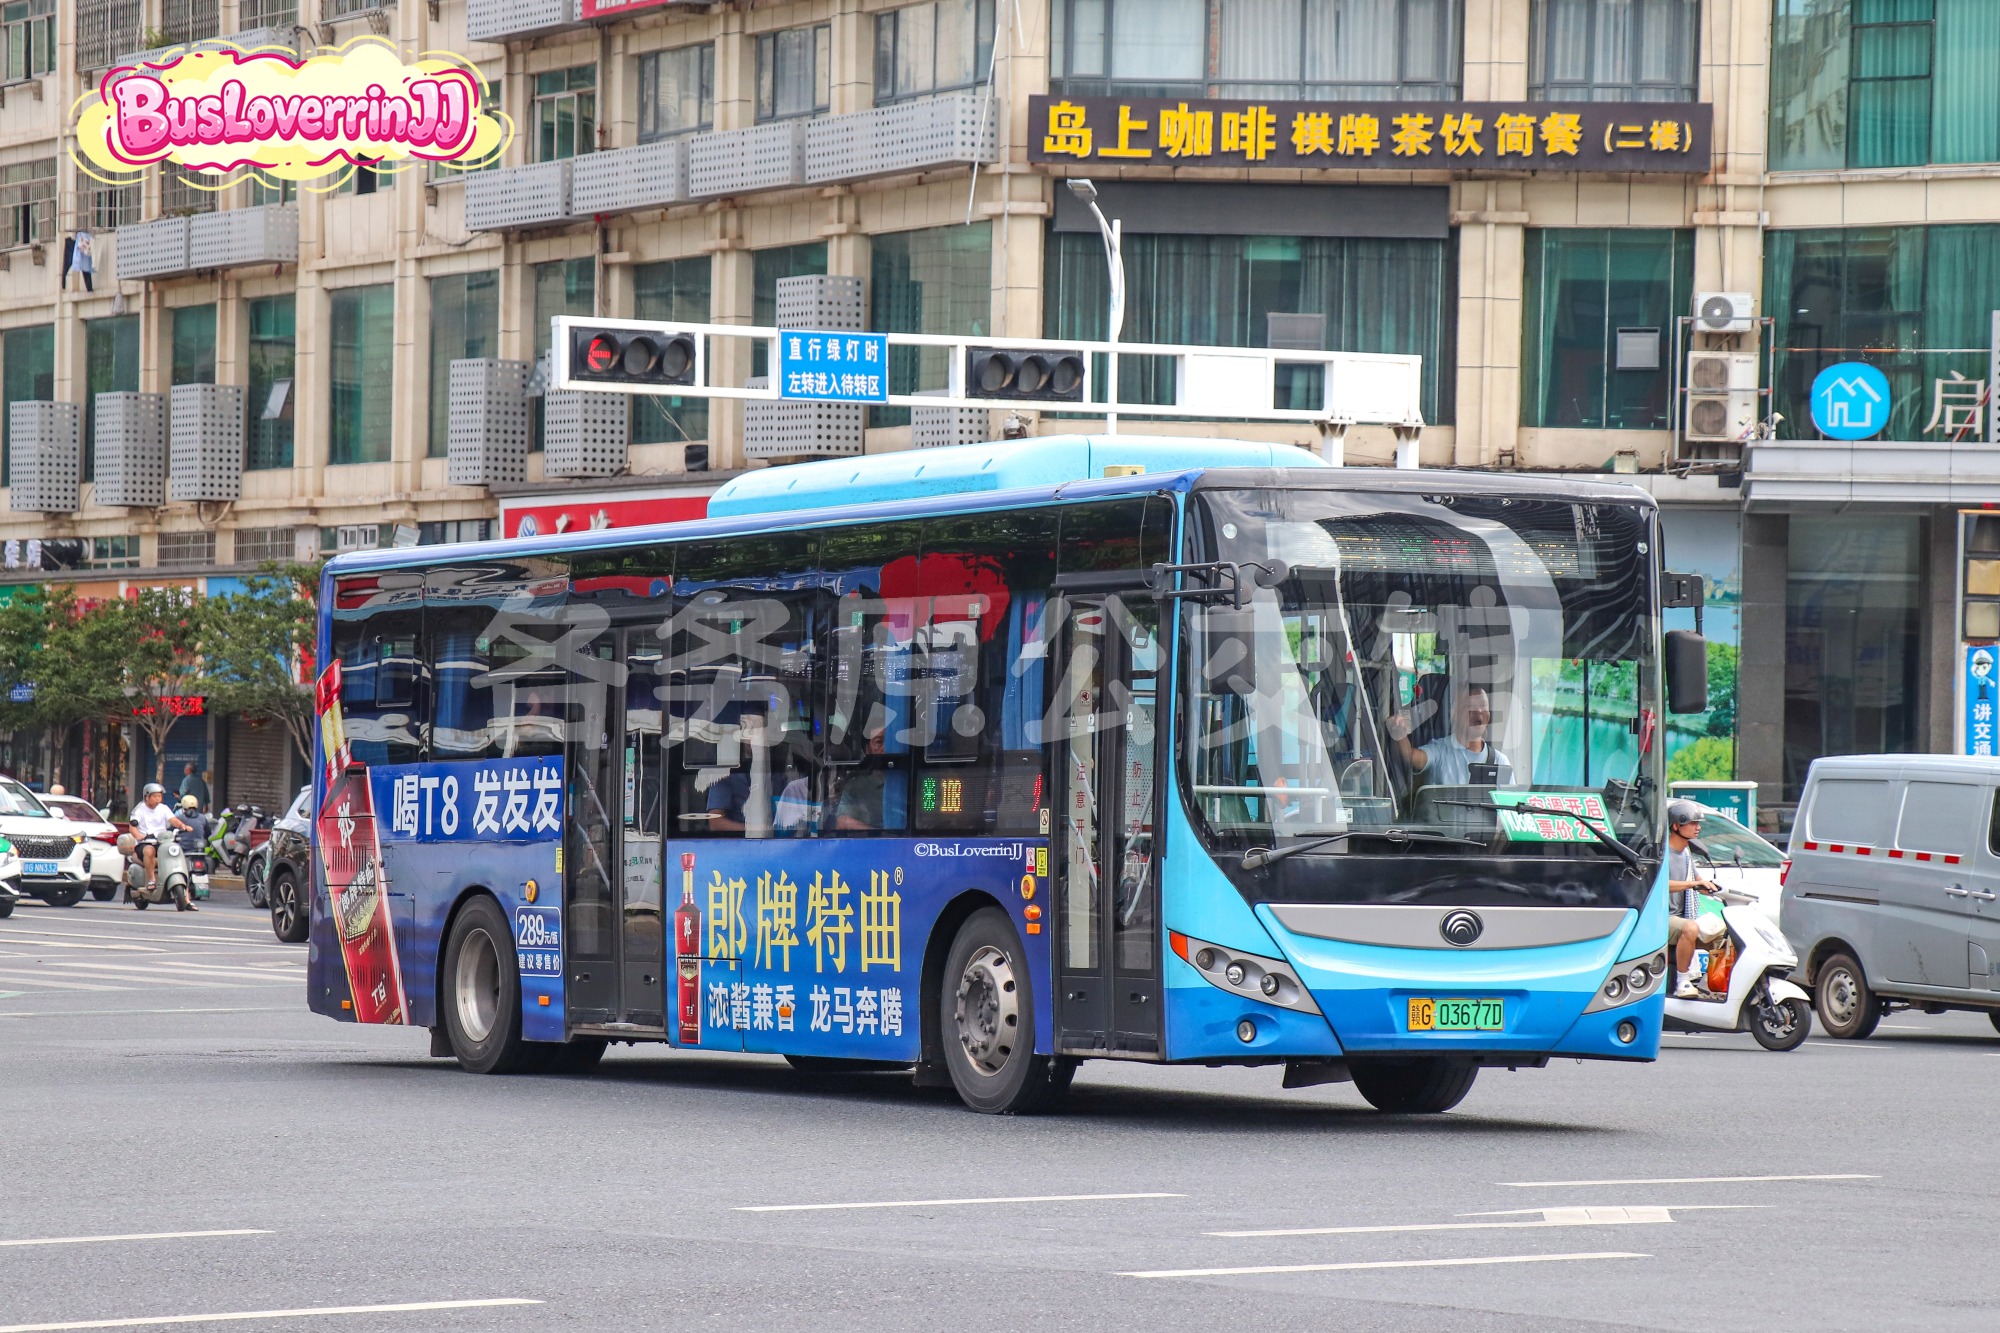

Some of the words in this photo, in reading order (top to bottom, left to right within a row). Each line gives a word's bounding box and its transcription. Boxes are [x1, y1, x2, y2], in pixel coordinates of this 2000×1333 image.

[1044, 101, 1277, 160] 岛上咖啡
[1291, 110, 1582, 157] 棋牌茶饮简餐
[788, 336, 879, 363] 直行绿灯时
[788, 371, 880, 396] 左转进入待转区
[1922, 369, 1985, 435] 启
[1973, 703, 1993, 756] 讲交通
[392, 775, 459, 836] 喝T8
[472, 766, 562, 835] 发发发
[1075, 762, 1087, 865] 注意开门
[708, 869, 902, 973] 郎牌特曲
[518, 953, 560, 971] 建议零售价
[708, 982, 796, 1032] 浓酱兼香
[809, 984, 902, 1037] 龙马奔腾
[1440, 1003, 1502, 1026] 03677D
